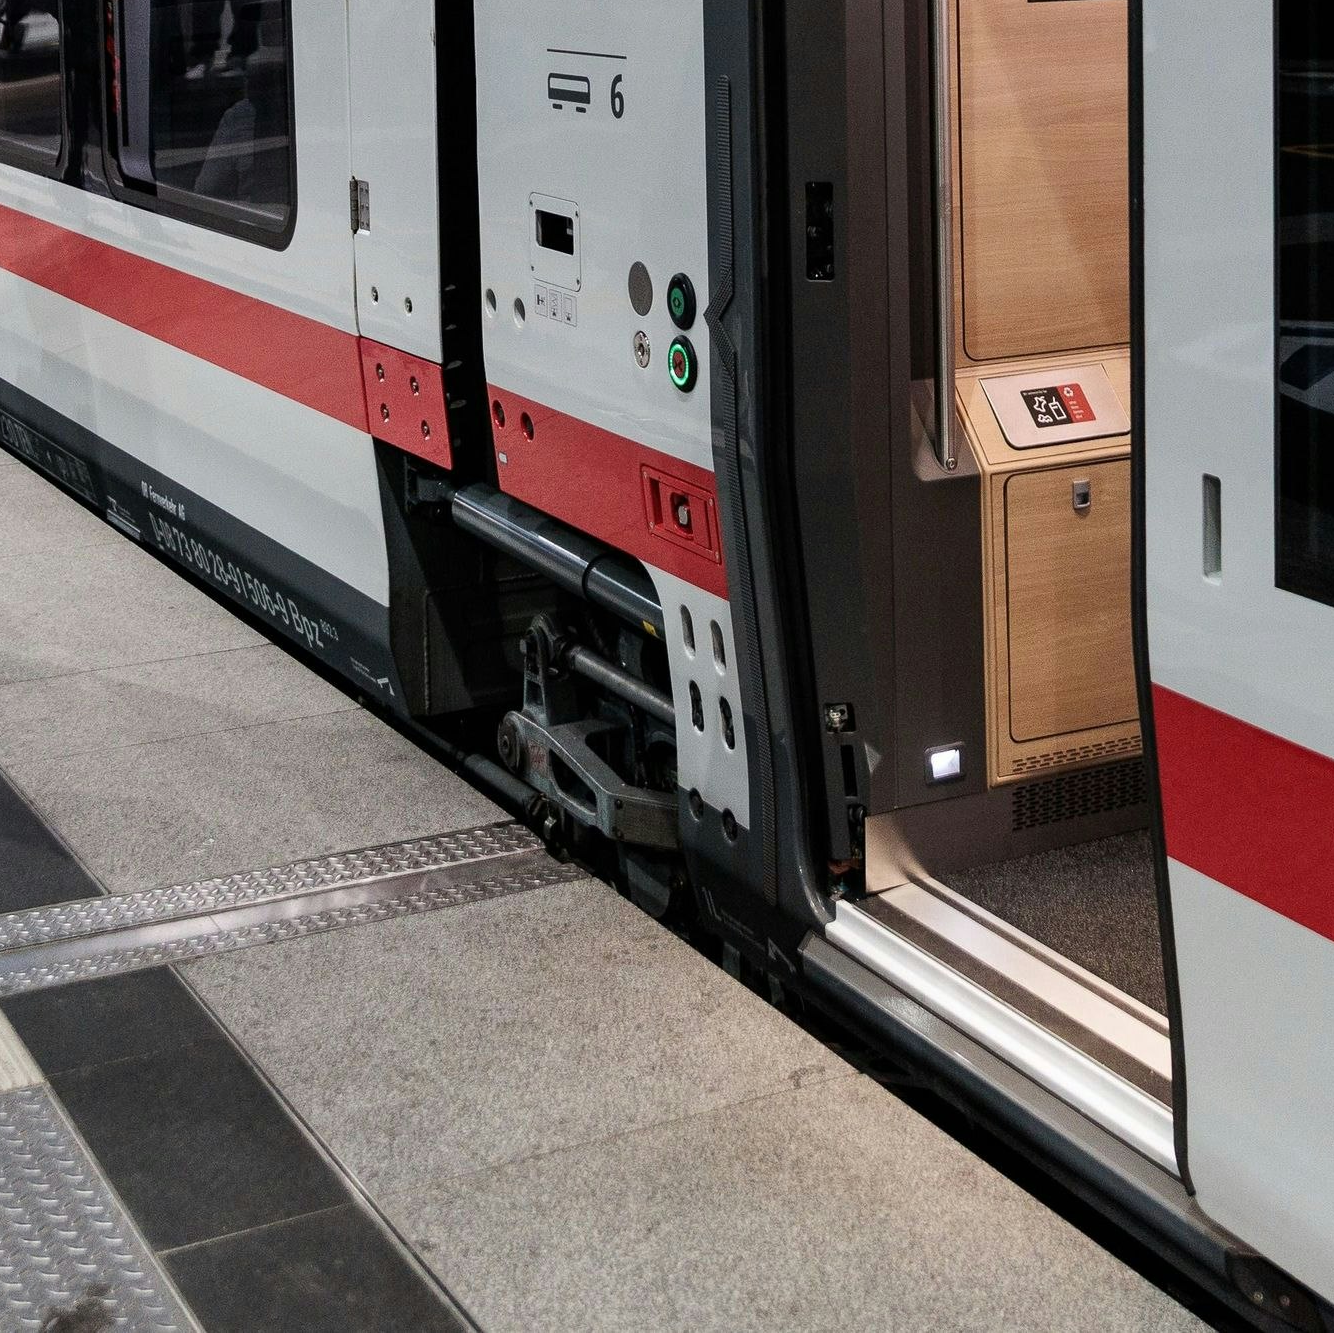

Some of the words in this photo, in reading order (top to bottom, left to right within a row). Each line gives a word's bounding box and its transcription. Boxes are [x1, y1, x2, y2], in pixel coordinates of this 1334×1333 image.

[611, 74, 624, 119] 6
[172, 527, 192, 562] 73
[190, 538, 211, 574] 80
[208, 550, 248, 599] 28-91
[244, 571, 289, 625] 506-9
[287, 598, 324, 648] Bpz
